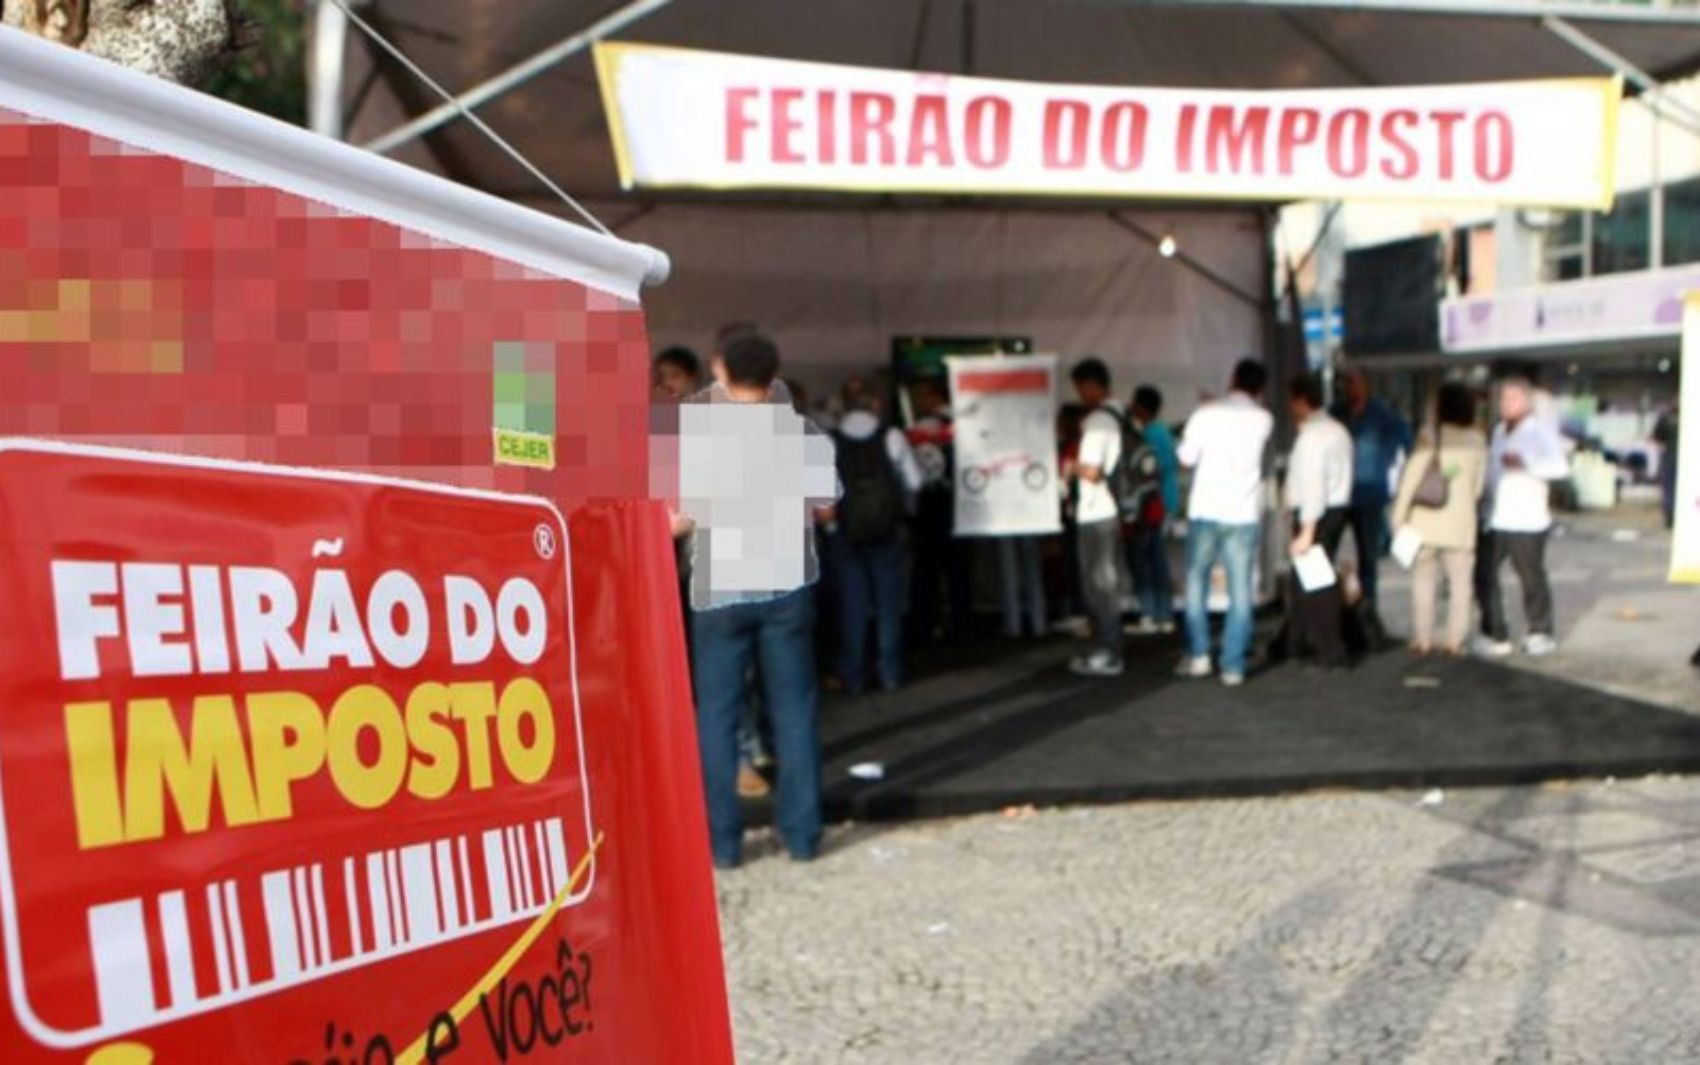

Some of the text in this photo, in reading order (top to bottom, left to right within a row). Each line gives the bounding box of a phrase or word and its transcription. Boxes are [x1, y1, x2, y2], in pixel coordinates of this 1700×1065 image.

[724, 74, 1515, 183] FEIRÃO DO IMPOSTO
[50, 538, 547, 680] FEIRÃO DO
[64, 676, 556, 850] IMPOSTO
